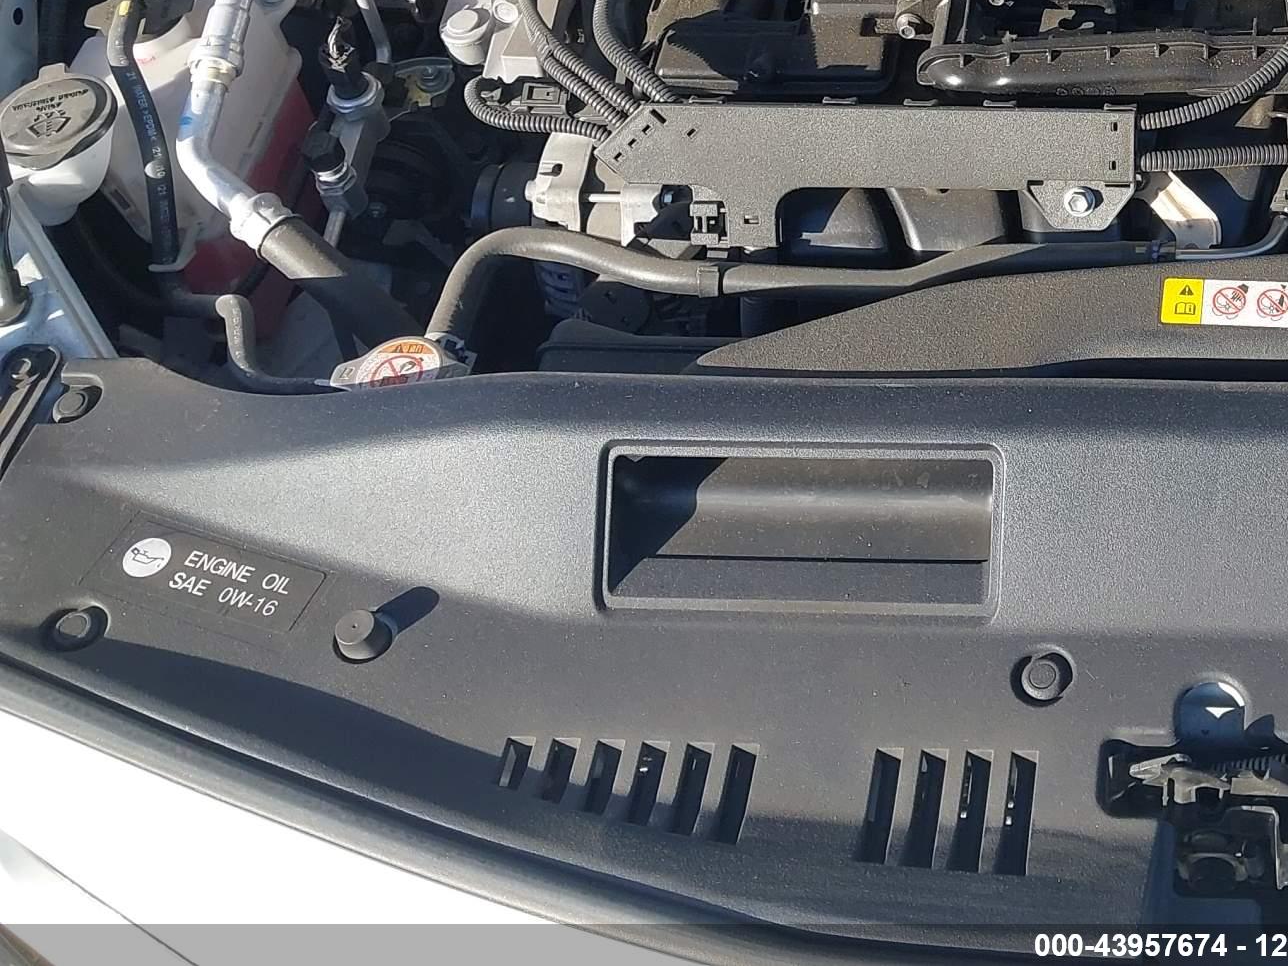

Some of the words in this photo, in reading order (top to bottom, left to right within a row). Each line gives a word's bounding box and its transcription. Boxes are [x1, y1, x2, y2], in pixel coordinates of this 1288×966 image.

[169, 572, 212, 596] SAE
[218, 587, 278, 616] 0W-16
[184, 550, 256, 582] ENGINE
[262, 574, 290, 594] OIL
